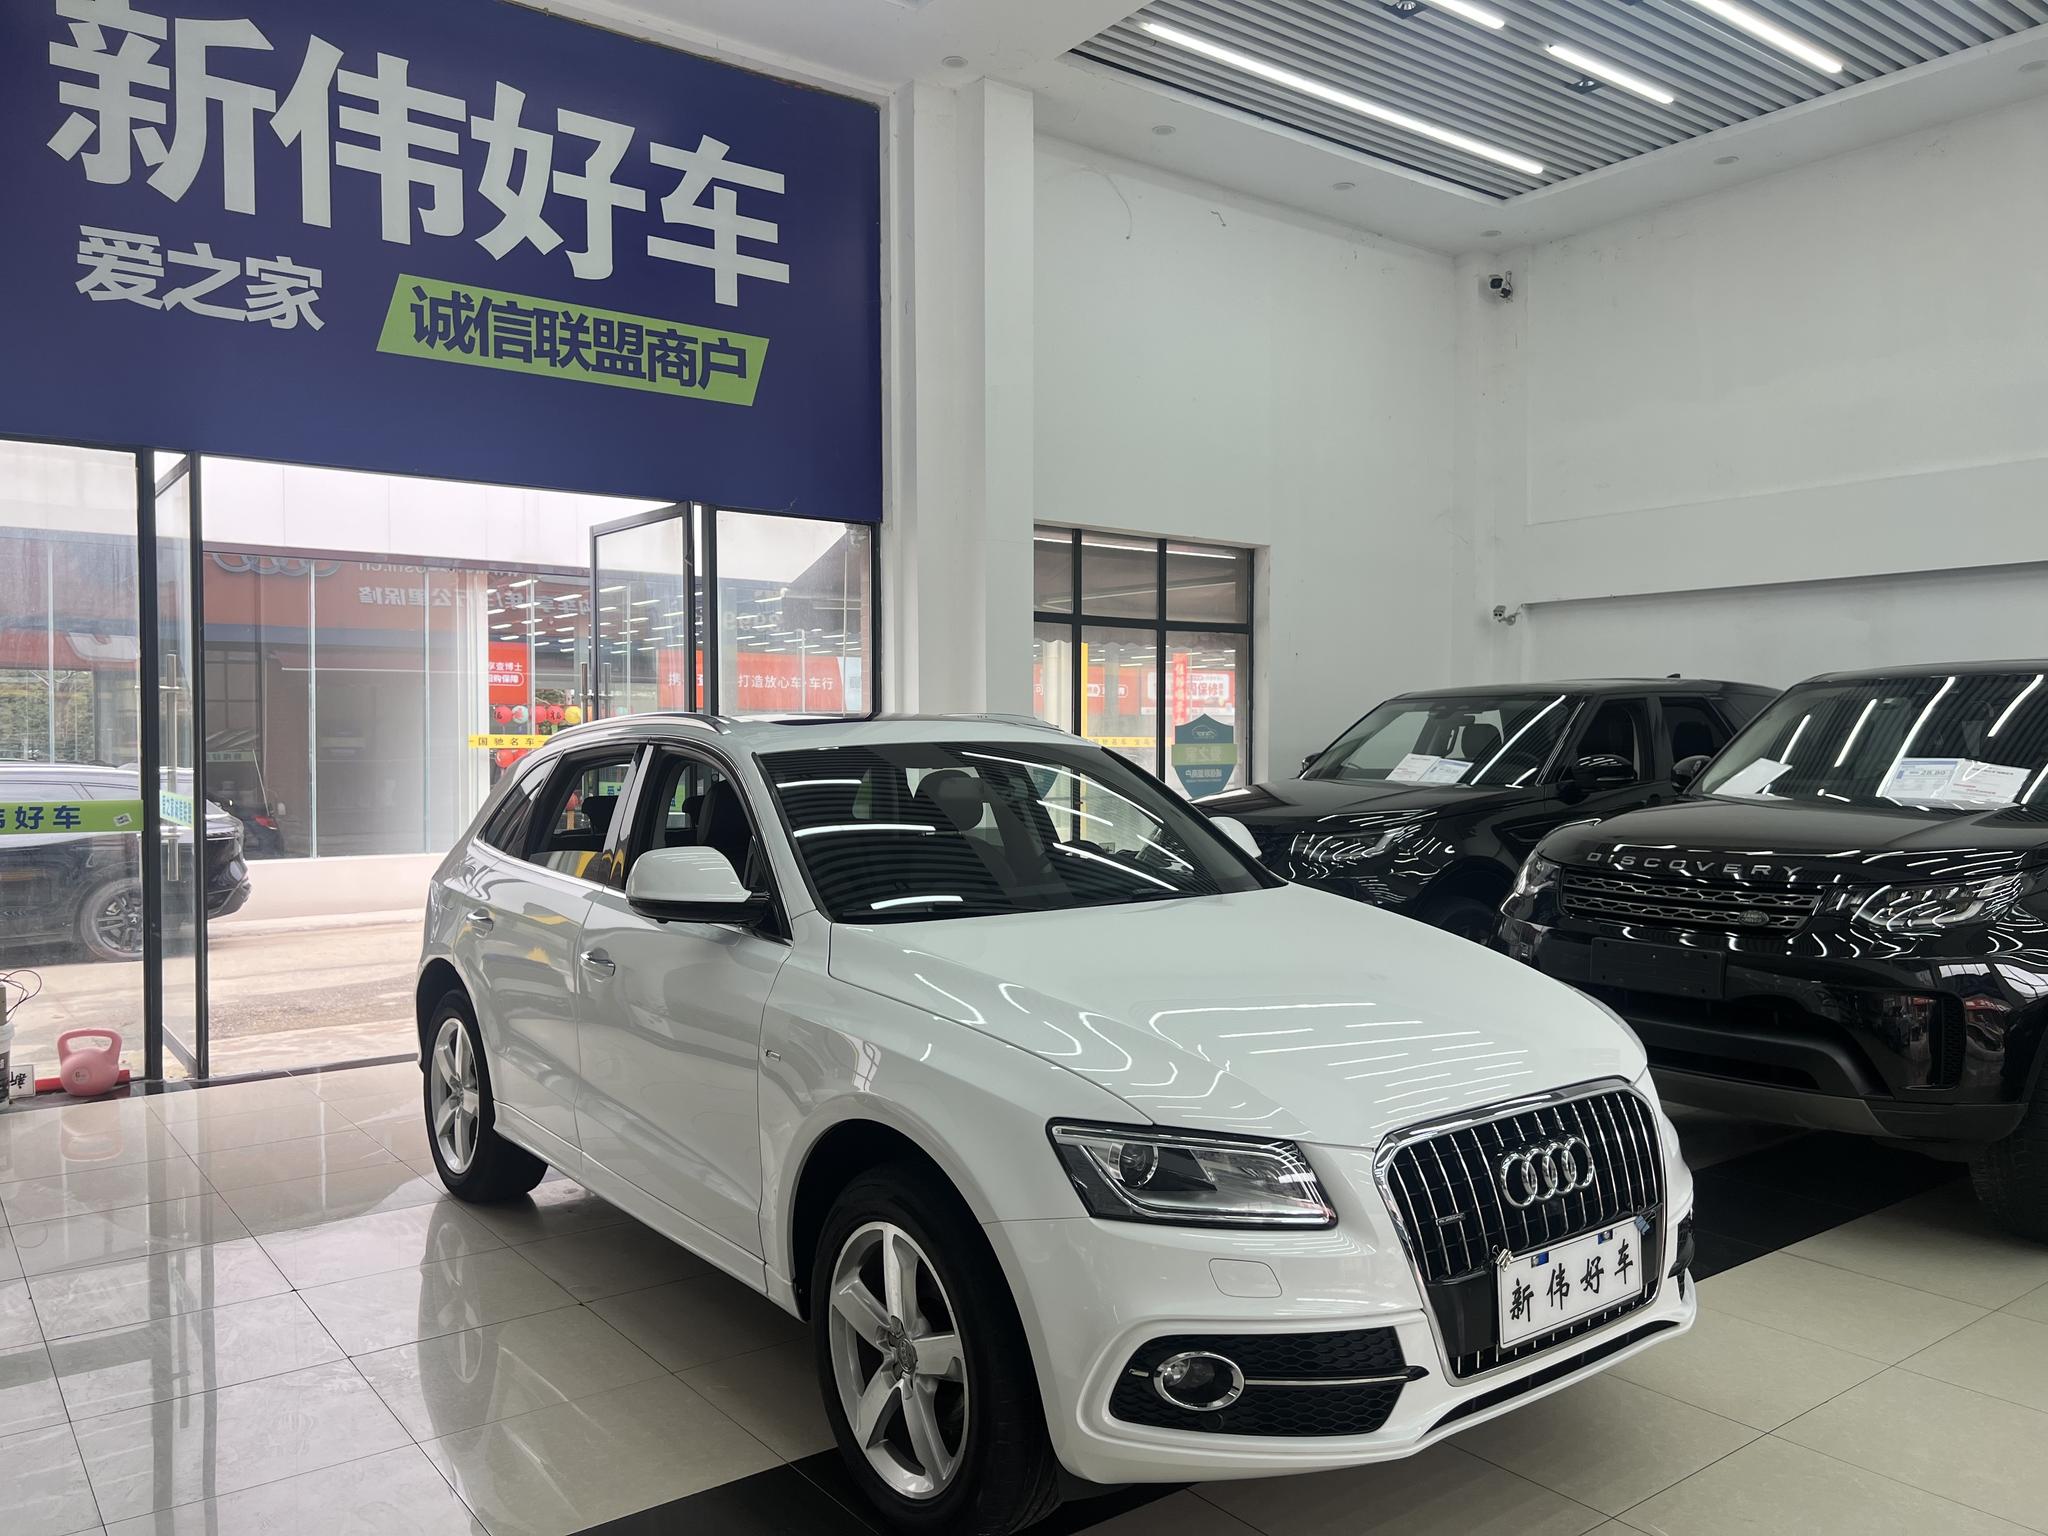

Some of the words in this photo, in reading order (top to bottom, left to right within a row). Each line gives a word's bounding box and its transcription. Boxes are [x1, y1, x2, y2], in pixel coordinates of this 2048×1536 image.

[46, 0, 790, 308] 新伟好车
[76, 224, 325, 332] 爱之家
[409, 285, 748, 390] 诚信联盟商户
[0, 805, 81, 830] 好车
[1586, 852, 1803, 876] DISCOVERY
[1509, 1238, 1634, 1323] 新伟好车
